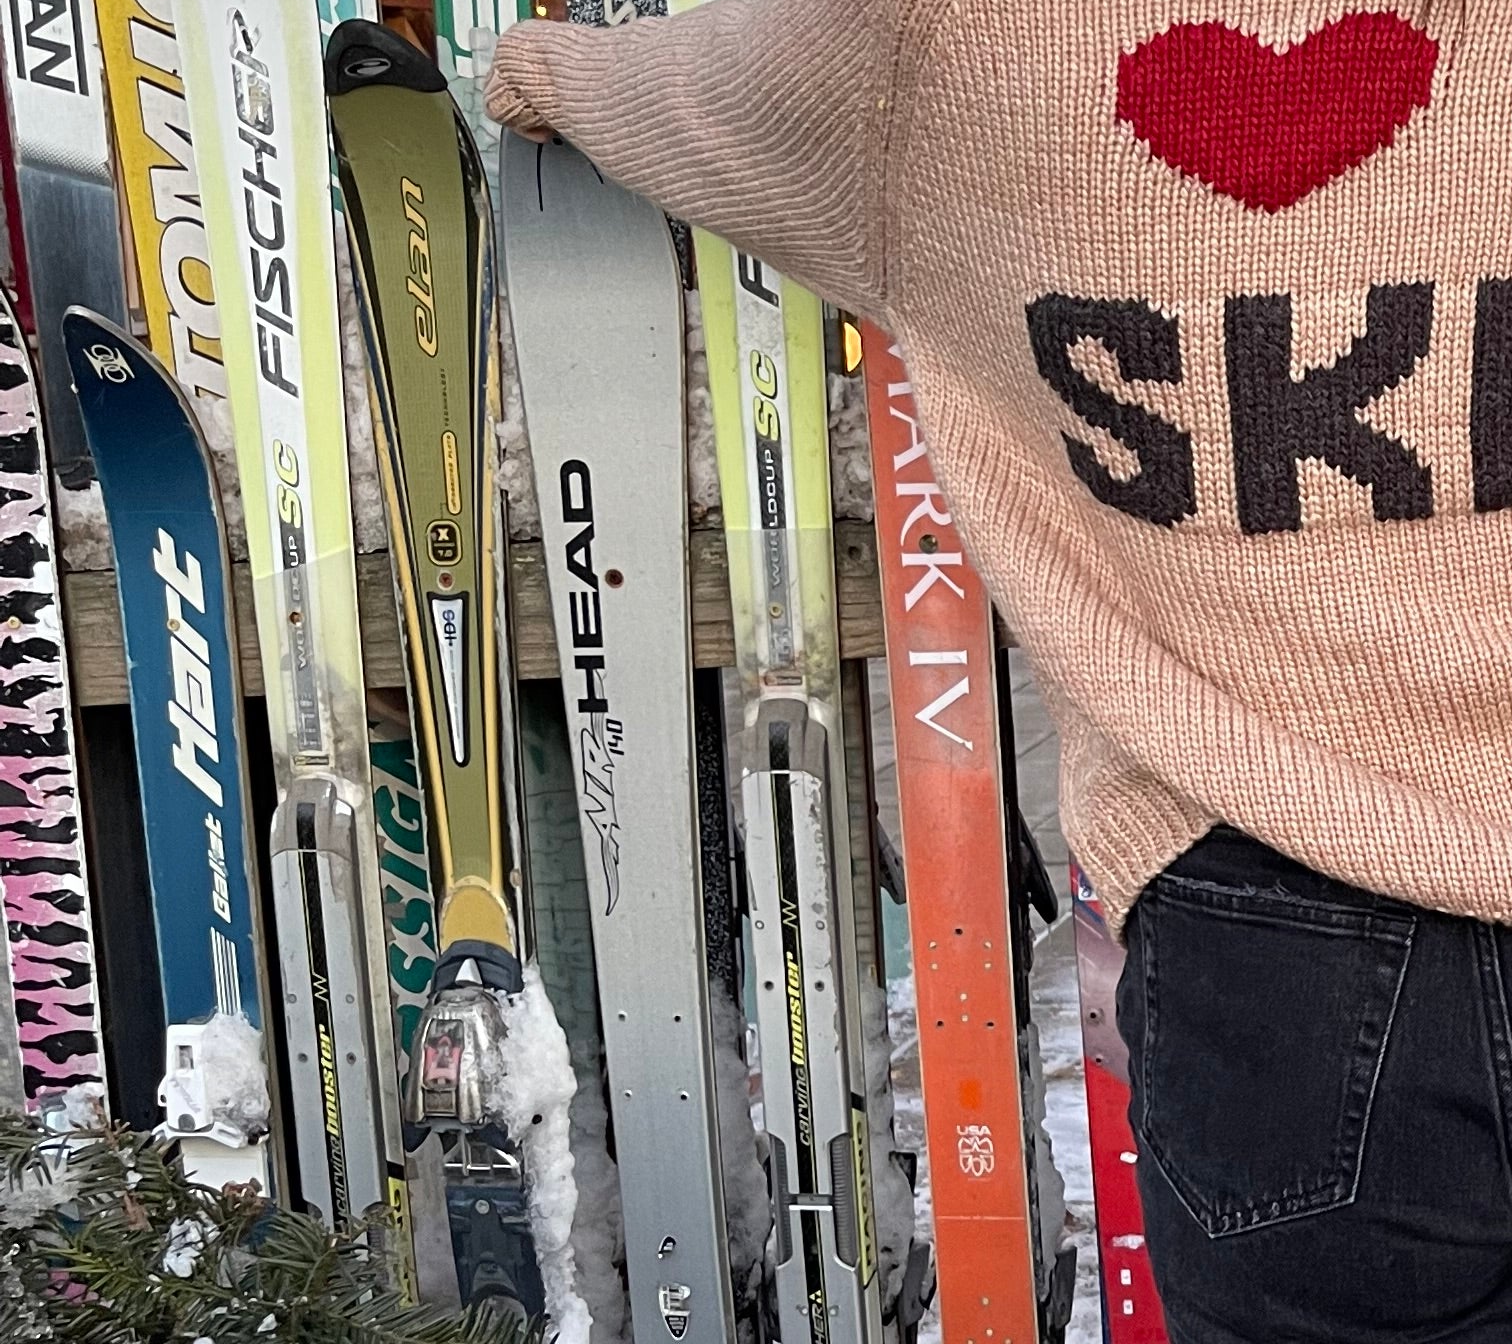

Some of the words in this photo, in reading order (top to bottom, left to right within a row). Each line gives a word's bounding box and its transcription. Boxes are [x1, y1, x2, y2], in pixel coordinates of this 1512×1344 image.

[230, 7, 300, 399] FISCHER
[400, 176, 440, 359] elan
[749, 350, 780, 442] SC
[272, 438, 302, 529] SC
[888, 344, 965, 613] ARK
[559, 459, 607, 714] HEAD
[154, 525, 224, 810] Hart
[908, 650, 974, 752] IV
[605, 719, 625, 756] 140
[784, 950, 806, 1066] booster
[317, 1022, 339, 1137] booster
[794, 1066, 812, 1147] carving
[956, 1123, 992, 1136] USA
